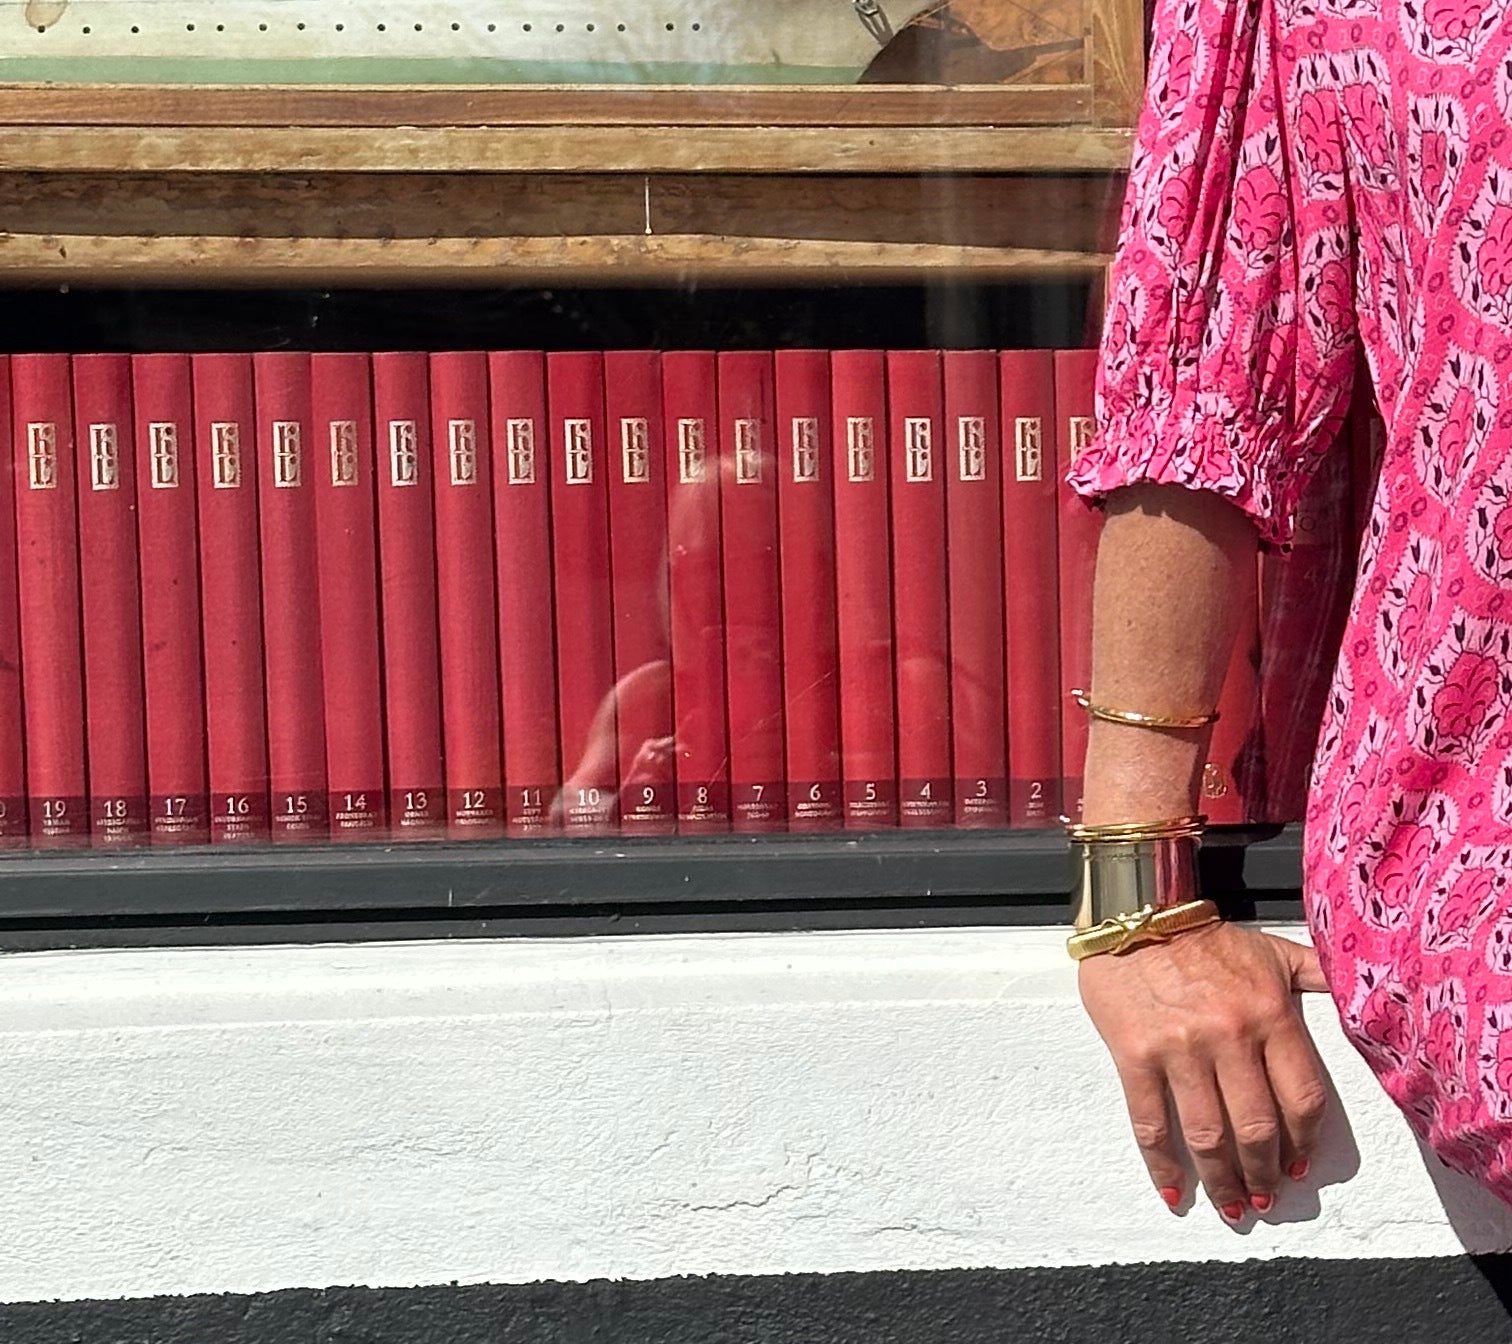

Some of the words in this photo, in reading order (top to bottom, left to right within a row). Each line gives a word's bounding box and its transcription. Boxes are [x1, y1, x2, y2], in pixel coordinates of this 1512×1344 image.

[577, 788, 600, 806] 10
[643, 787, 655, 805] 9
[697, 786, 708, 804] 8
[752, 785, 764, 802] 7
[810, 784, 821, 801] 6
[865, 783, 876, 801] 5
[919, 782, 931, 800] 4
[976, 780, 988, 797] 3
[1030, 782, 1042, 799] 2
[164, 798, 187, 816] 17
[226, 796, 250, 814] 16
[285, 796, 308, 814] 15
[343, 793, 368, 811] 14
[404, 791, 428, 810] 13
[463, 791, 485, 809] 12
[521, 789, 543, 807] 11
[43, 800, 67, 818] 19
[103, 800, 128, 818] 18
